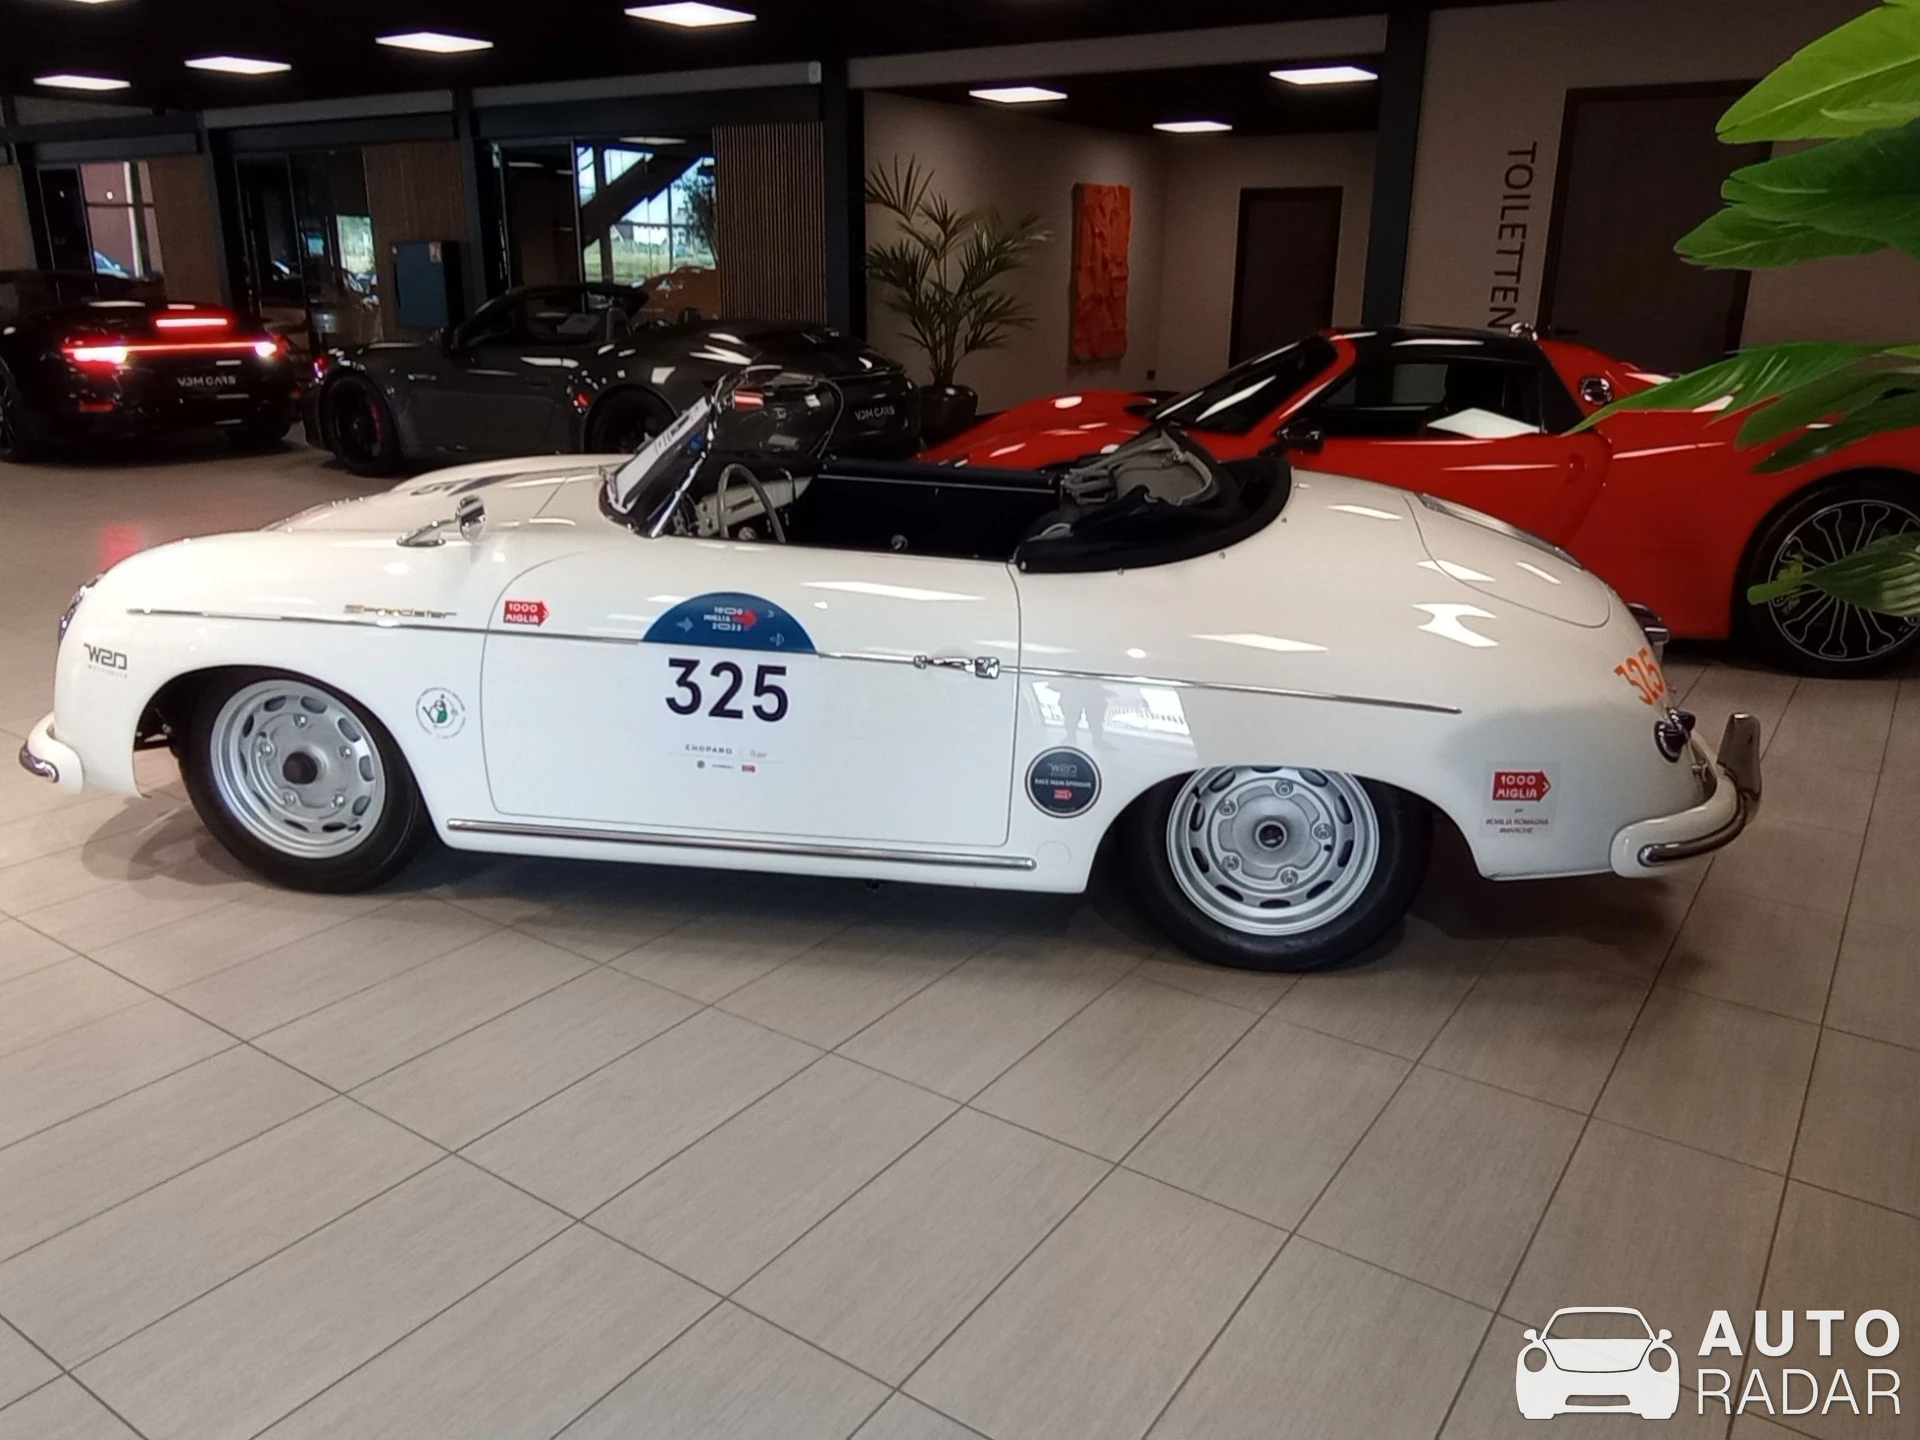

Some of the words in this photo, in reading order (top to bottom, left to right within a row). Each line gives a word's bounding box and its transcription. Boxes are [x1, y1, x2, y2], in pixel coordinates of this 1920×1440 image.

[1487, 141, 1537, 329] TOILETTEN
[508, 603, 538, 613] 1000
[506, 613, 539, 623] MIGLIA
[703, 614, 731, 622] MIGLIA
[1614, 647, 1665, 705] 325
[665, 657, 789, 723] 325
[685, 743, 733, 755] CHOPARD
[1500, 775, 1536, 786] 1000
[1496, 788, 1538, 799] MIGLIA
